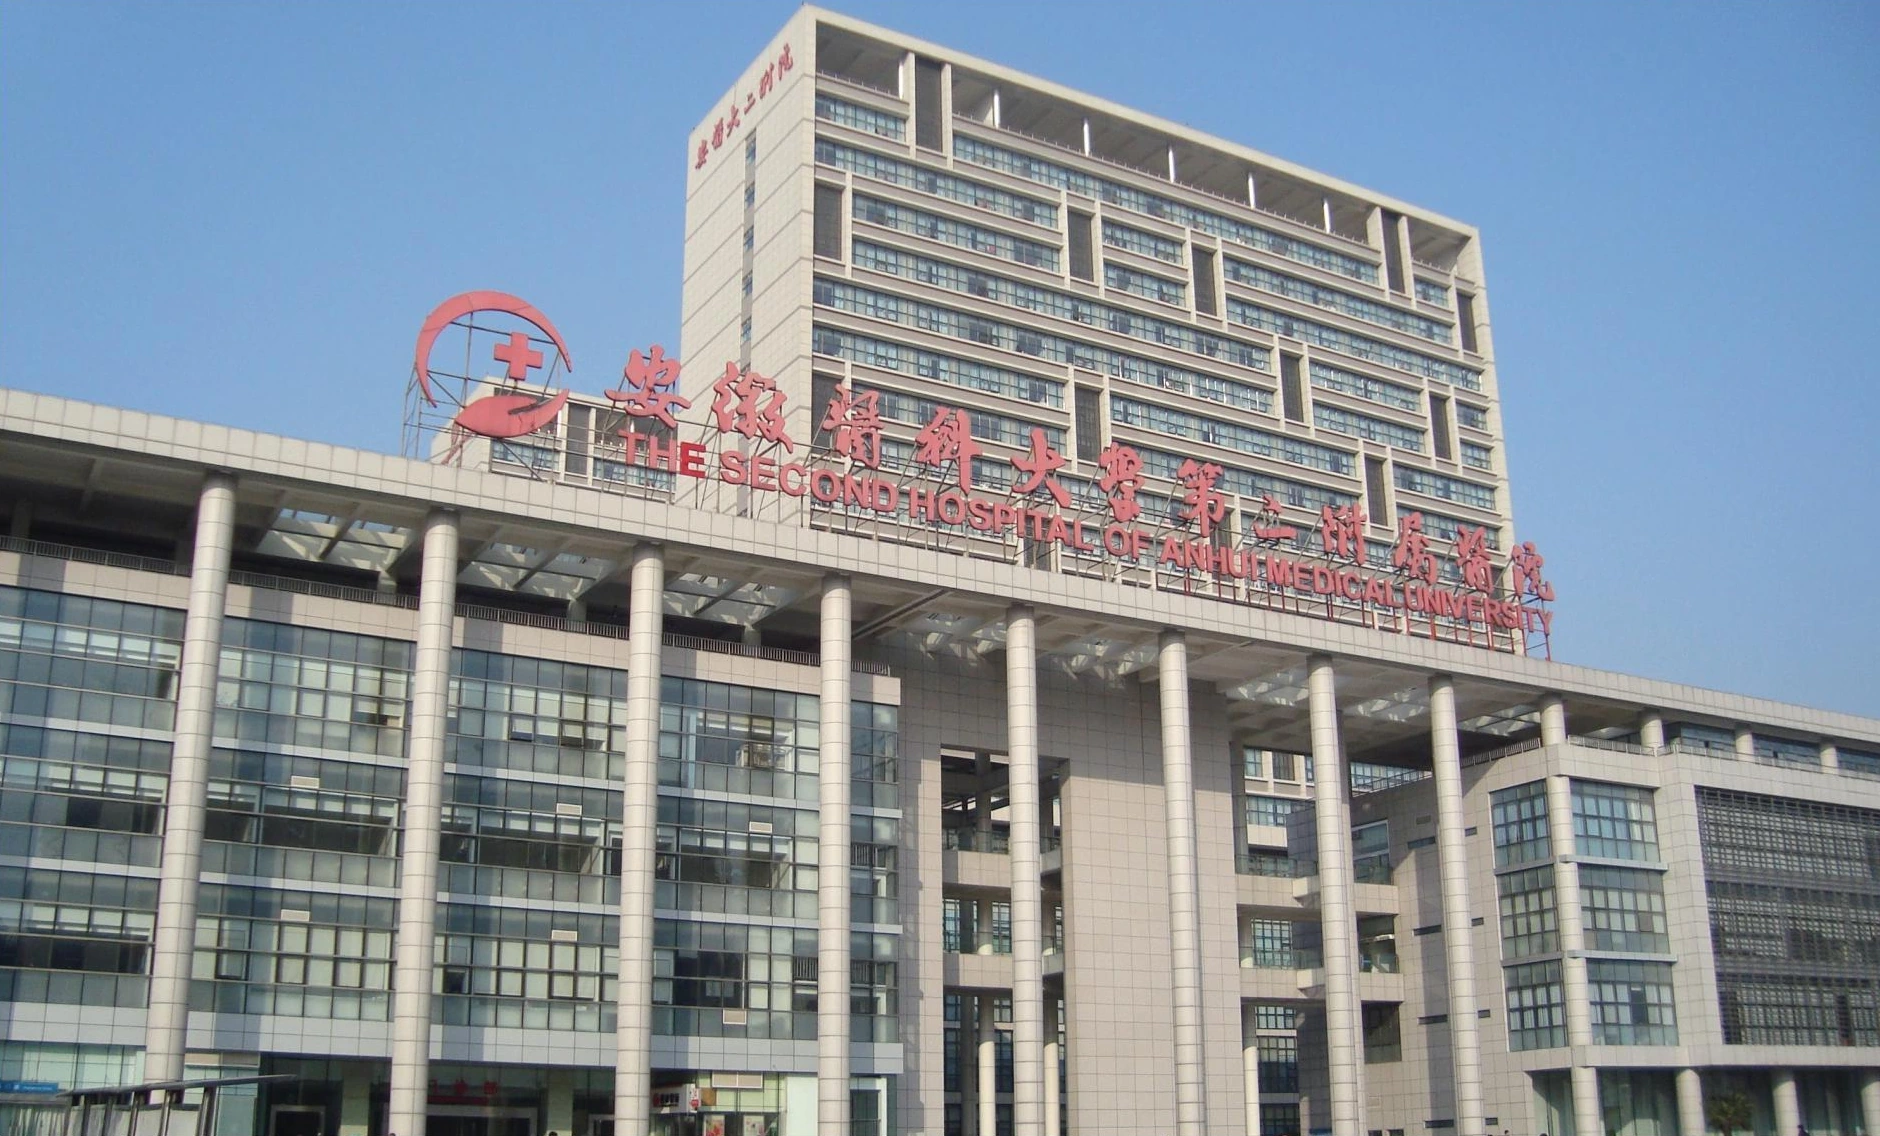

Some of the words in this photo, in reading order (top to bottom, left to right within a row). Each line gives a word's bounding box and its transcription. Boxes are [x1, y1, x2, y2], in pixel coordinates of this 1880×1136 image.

[617, 429, 707, 479] THE
[719, 449, 899, 513] SECOND
[908, 486, 1094, 552] HOSPITAL
[1103, 524, 1151, 560] OF
[1159, 536, 1259, 582] ANHUI
[1264, 554, 1402, 608] MEDICAL
[1403, 581, 1555, 636] UNIVERSITY
